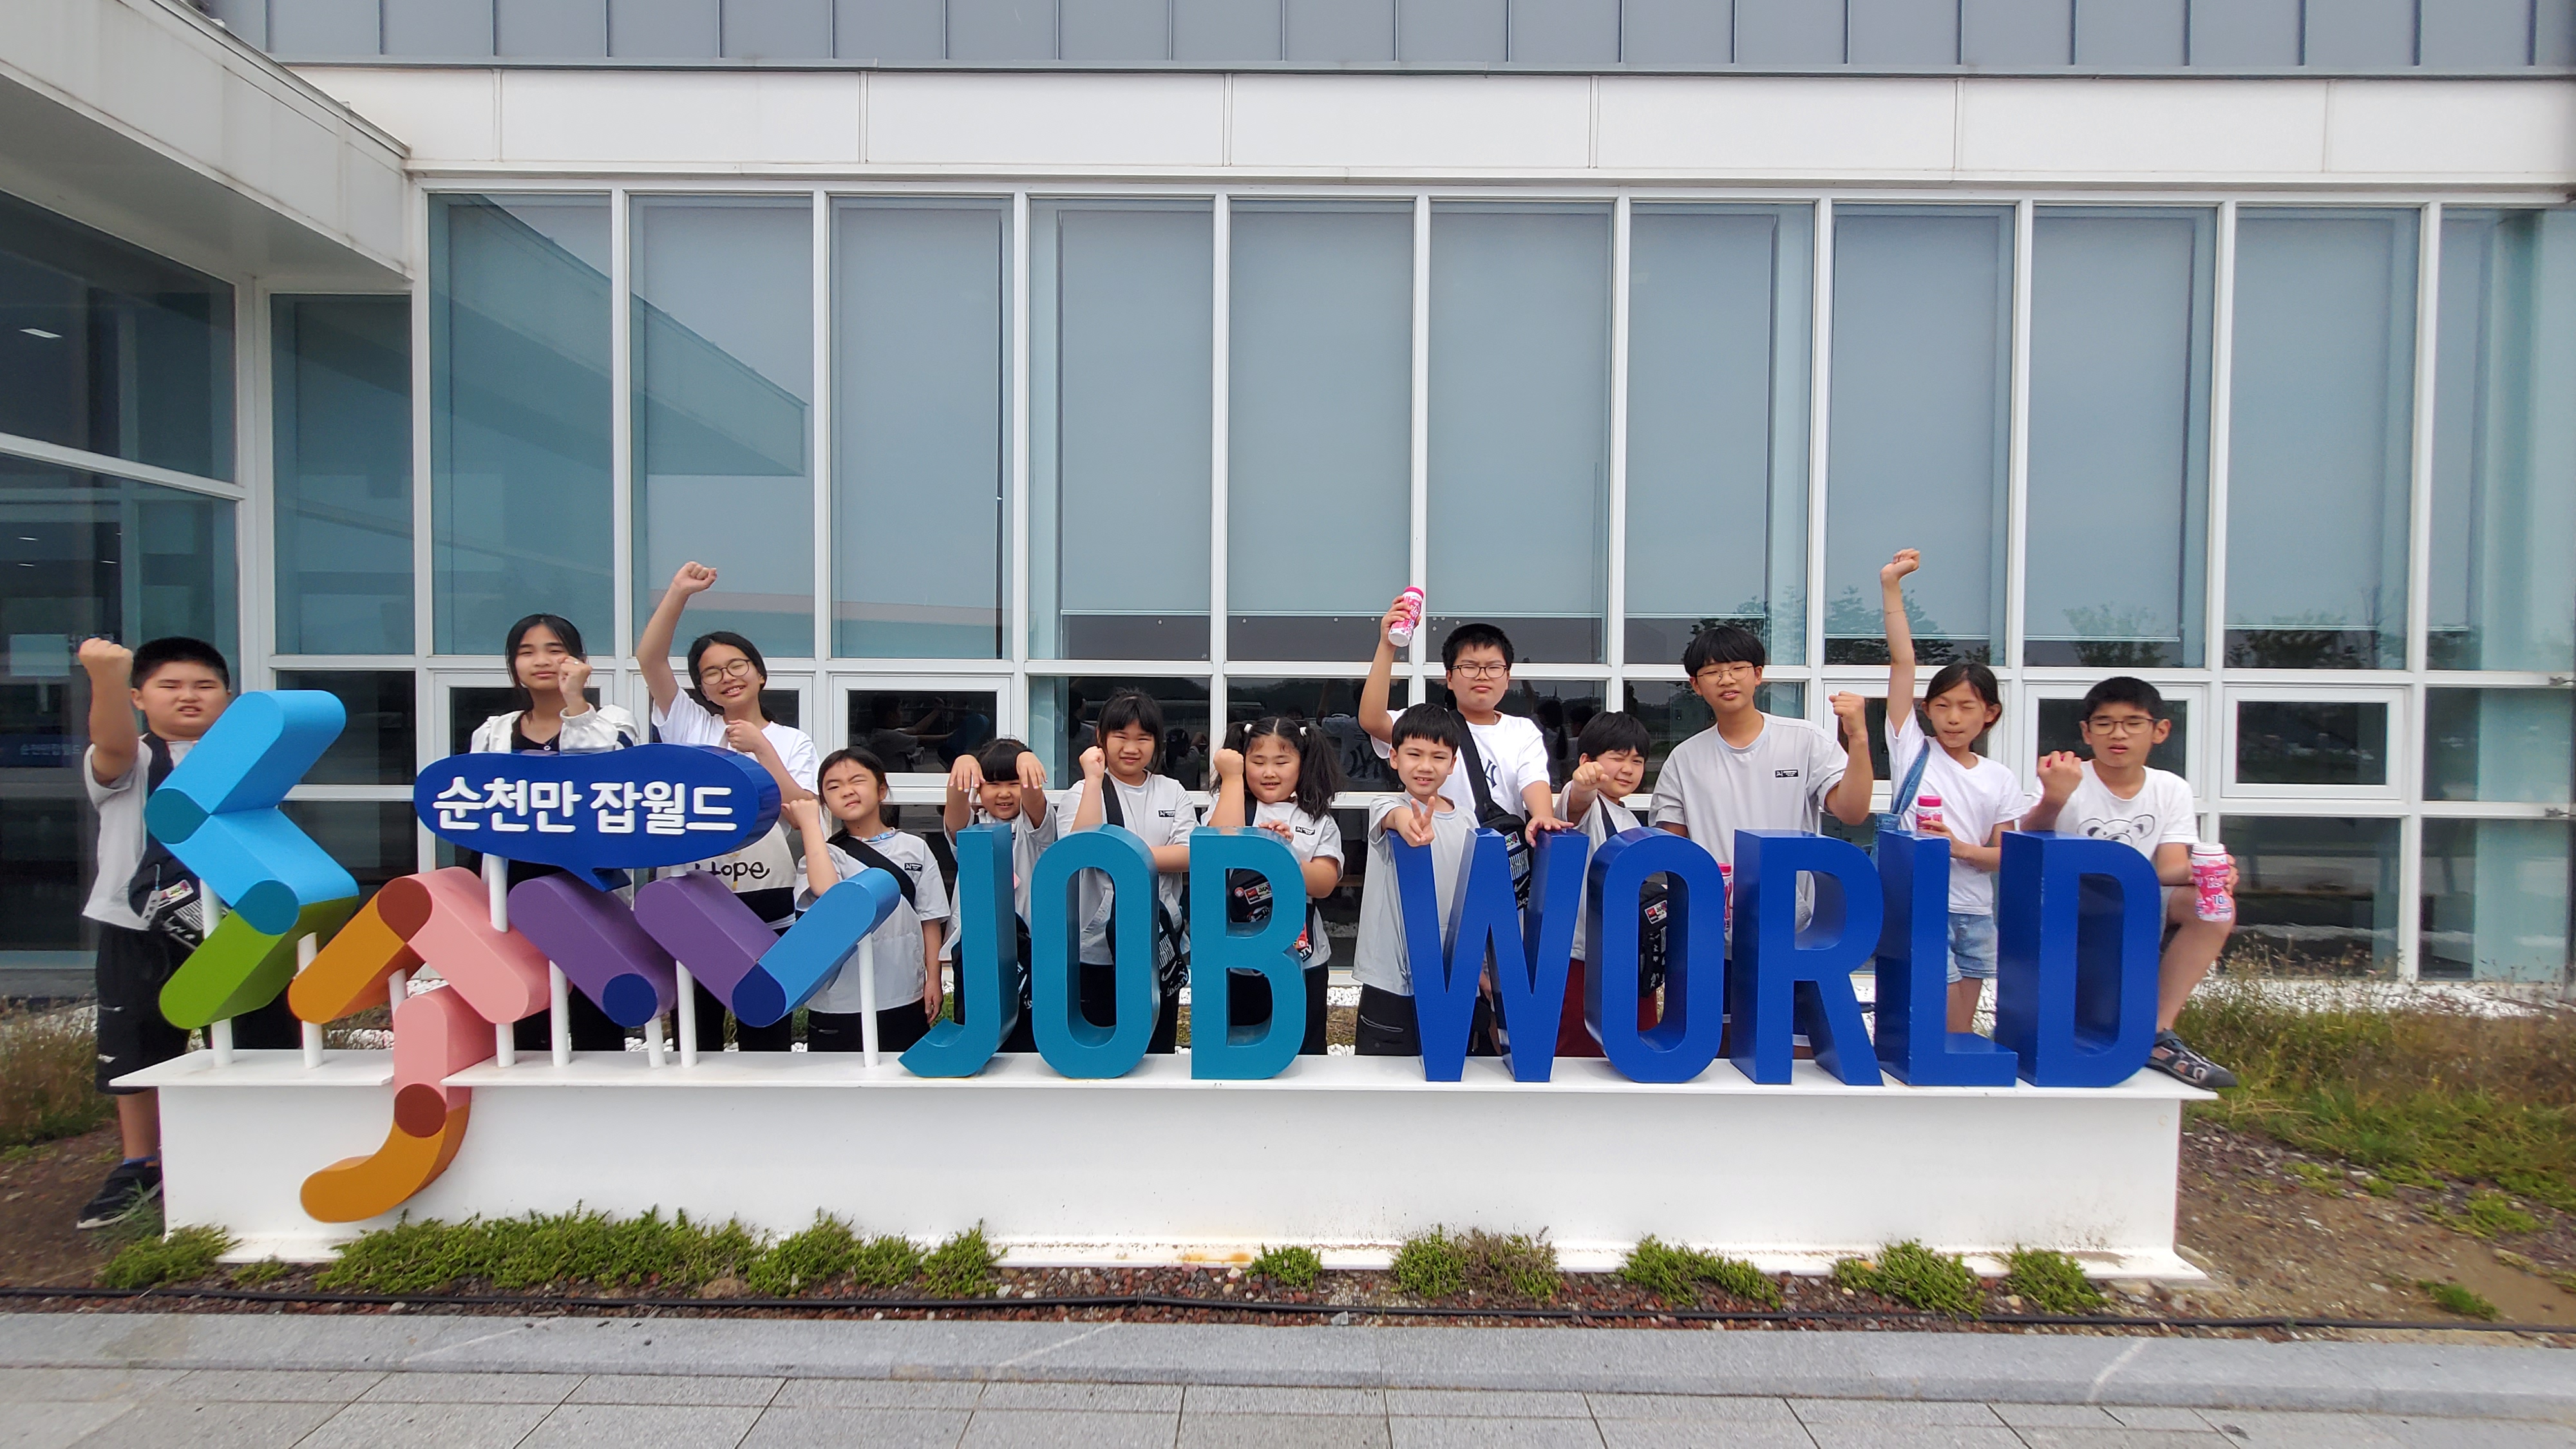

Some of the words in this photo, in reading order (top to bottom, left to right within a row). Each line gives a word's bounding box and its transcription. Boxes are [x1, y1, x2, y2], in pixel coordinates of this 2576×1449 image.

[433, 777, 583, 833] 순천만
[590, 781, 737, 835] 잡월드
[897, 823, 1307, 1080] JOB
[1387, 827, 2160, 1087] WORLD
